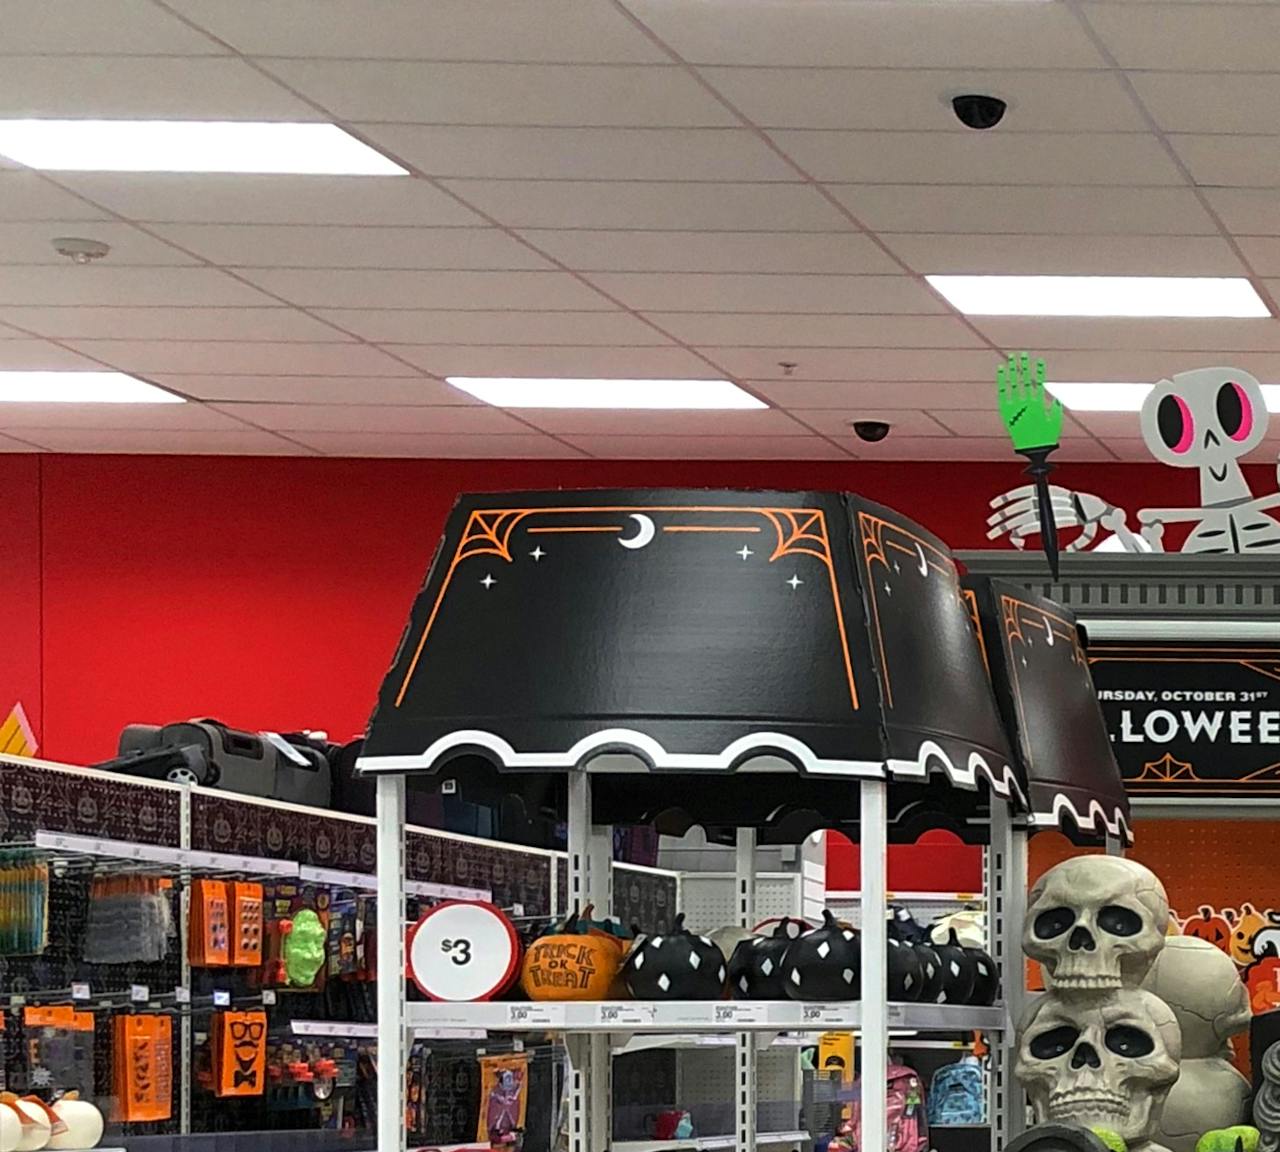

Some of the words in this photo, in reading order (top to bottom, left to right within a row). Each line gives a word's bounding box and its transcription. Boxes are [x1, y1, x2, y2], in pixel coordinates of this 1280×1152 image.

[1161, 690, 1236, 701] OCTOBER
[440, 938, 472, 965] $3
[534, 943, 597, 966] TRICK
[529, 965, 596, 989] TREAT
